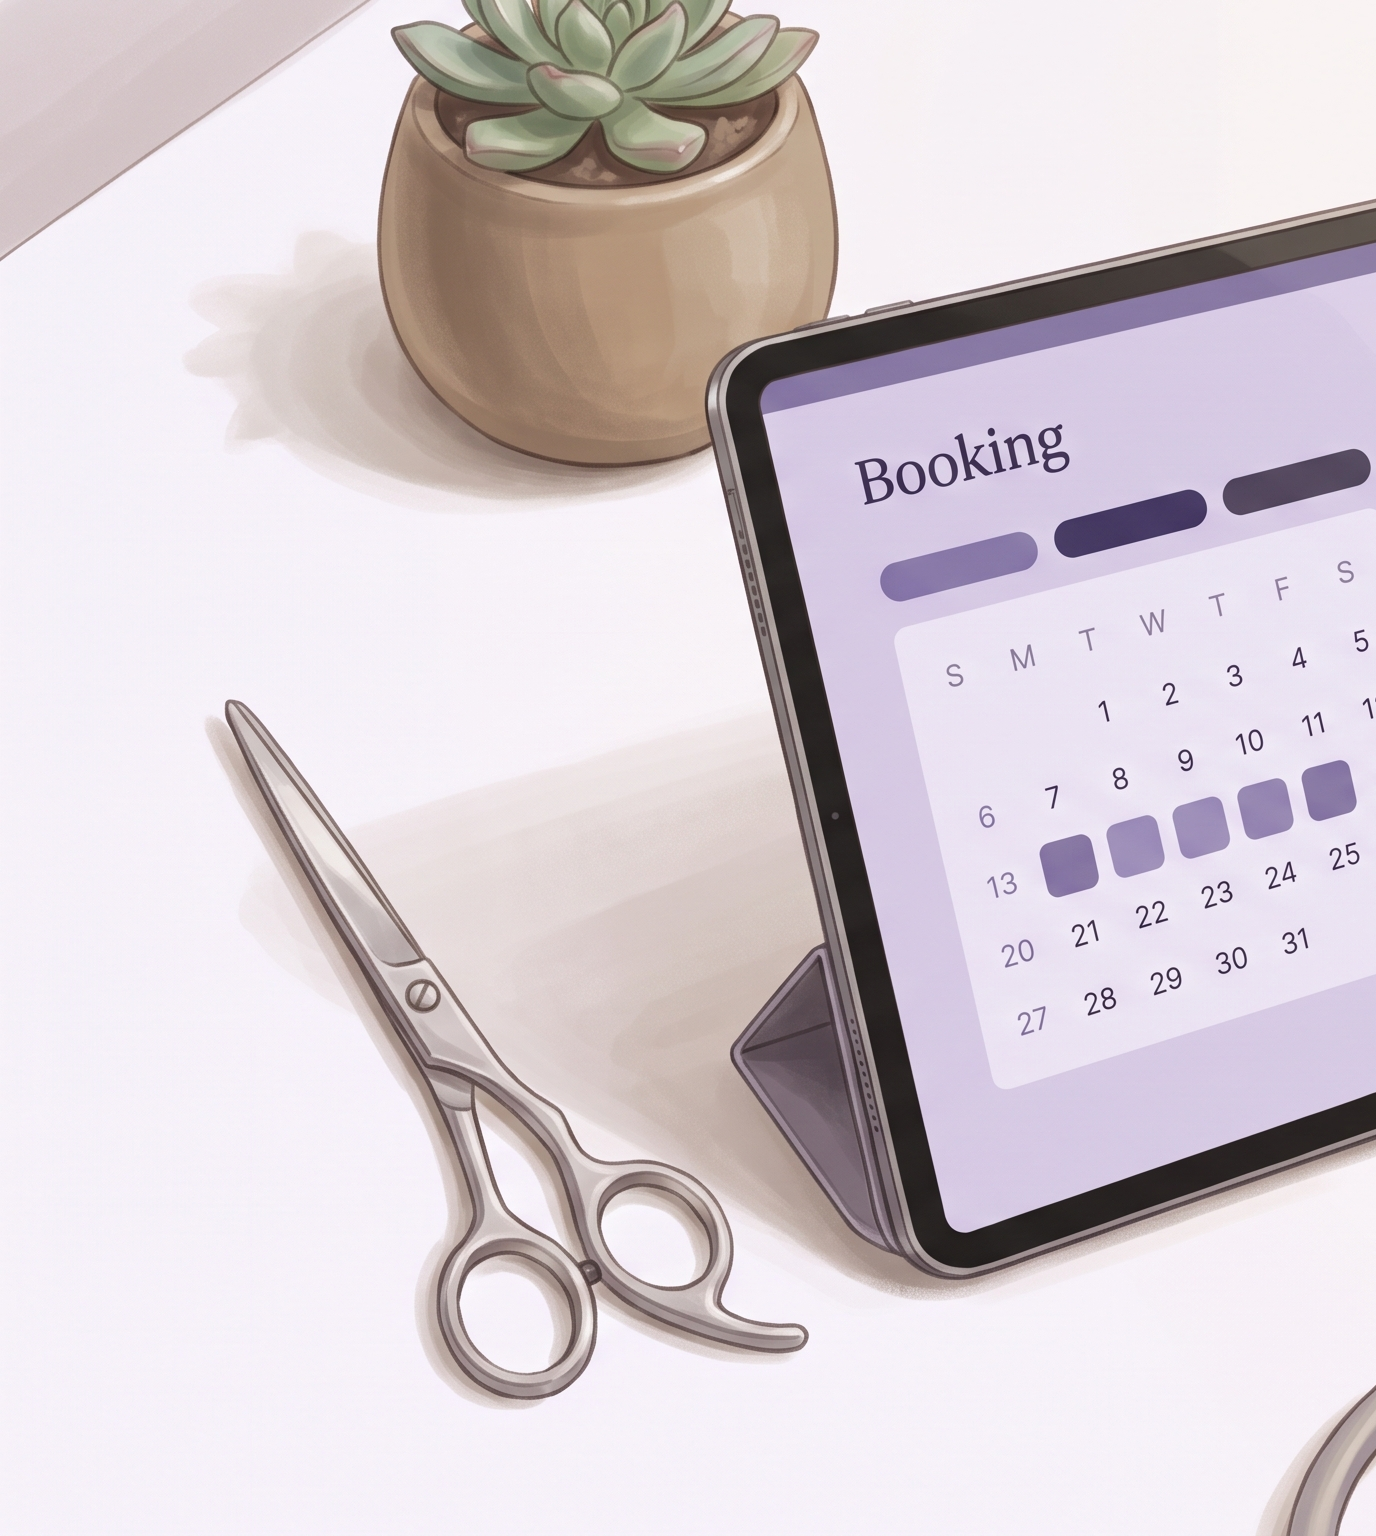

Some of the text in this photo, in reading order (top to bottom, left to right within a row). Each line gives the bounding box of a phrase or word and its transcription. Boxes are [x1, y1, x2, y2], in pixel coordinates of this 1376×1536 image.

[853, 423, 1071, 506] Booking
[945, 560, 1355, 688] S M T W T F S
[1097, 628, 1370, 723] 1 2 3 4 5
[978, 804, 996, 829] 6
[1044, 784, 1059, 810] 7
[1112, 766, 1129, 791] 8
[1177, 748, 1194, 773] 9
[1234, 728, 1264, 756] 10
[1301, 711, 1326, 737] 11
[986, 871, 1018, 899] 13
[1000, 938, 1035, 969] 20
[1071, 919, 1100, 949] 21
[1135, 900, 1169, 930] 22
[1200, 880, 1234, 910] 23
[1264, 860, 1297, 891] 24
[1328, 841, 1361, 872] 25
[1017, 927, 1309, 1037] 27 28 29 30 31
